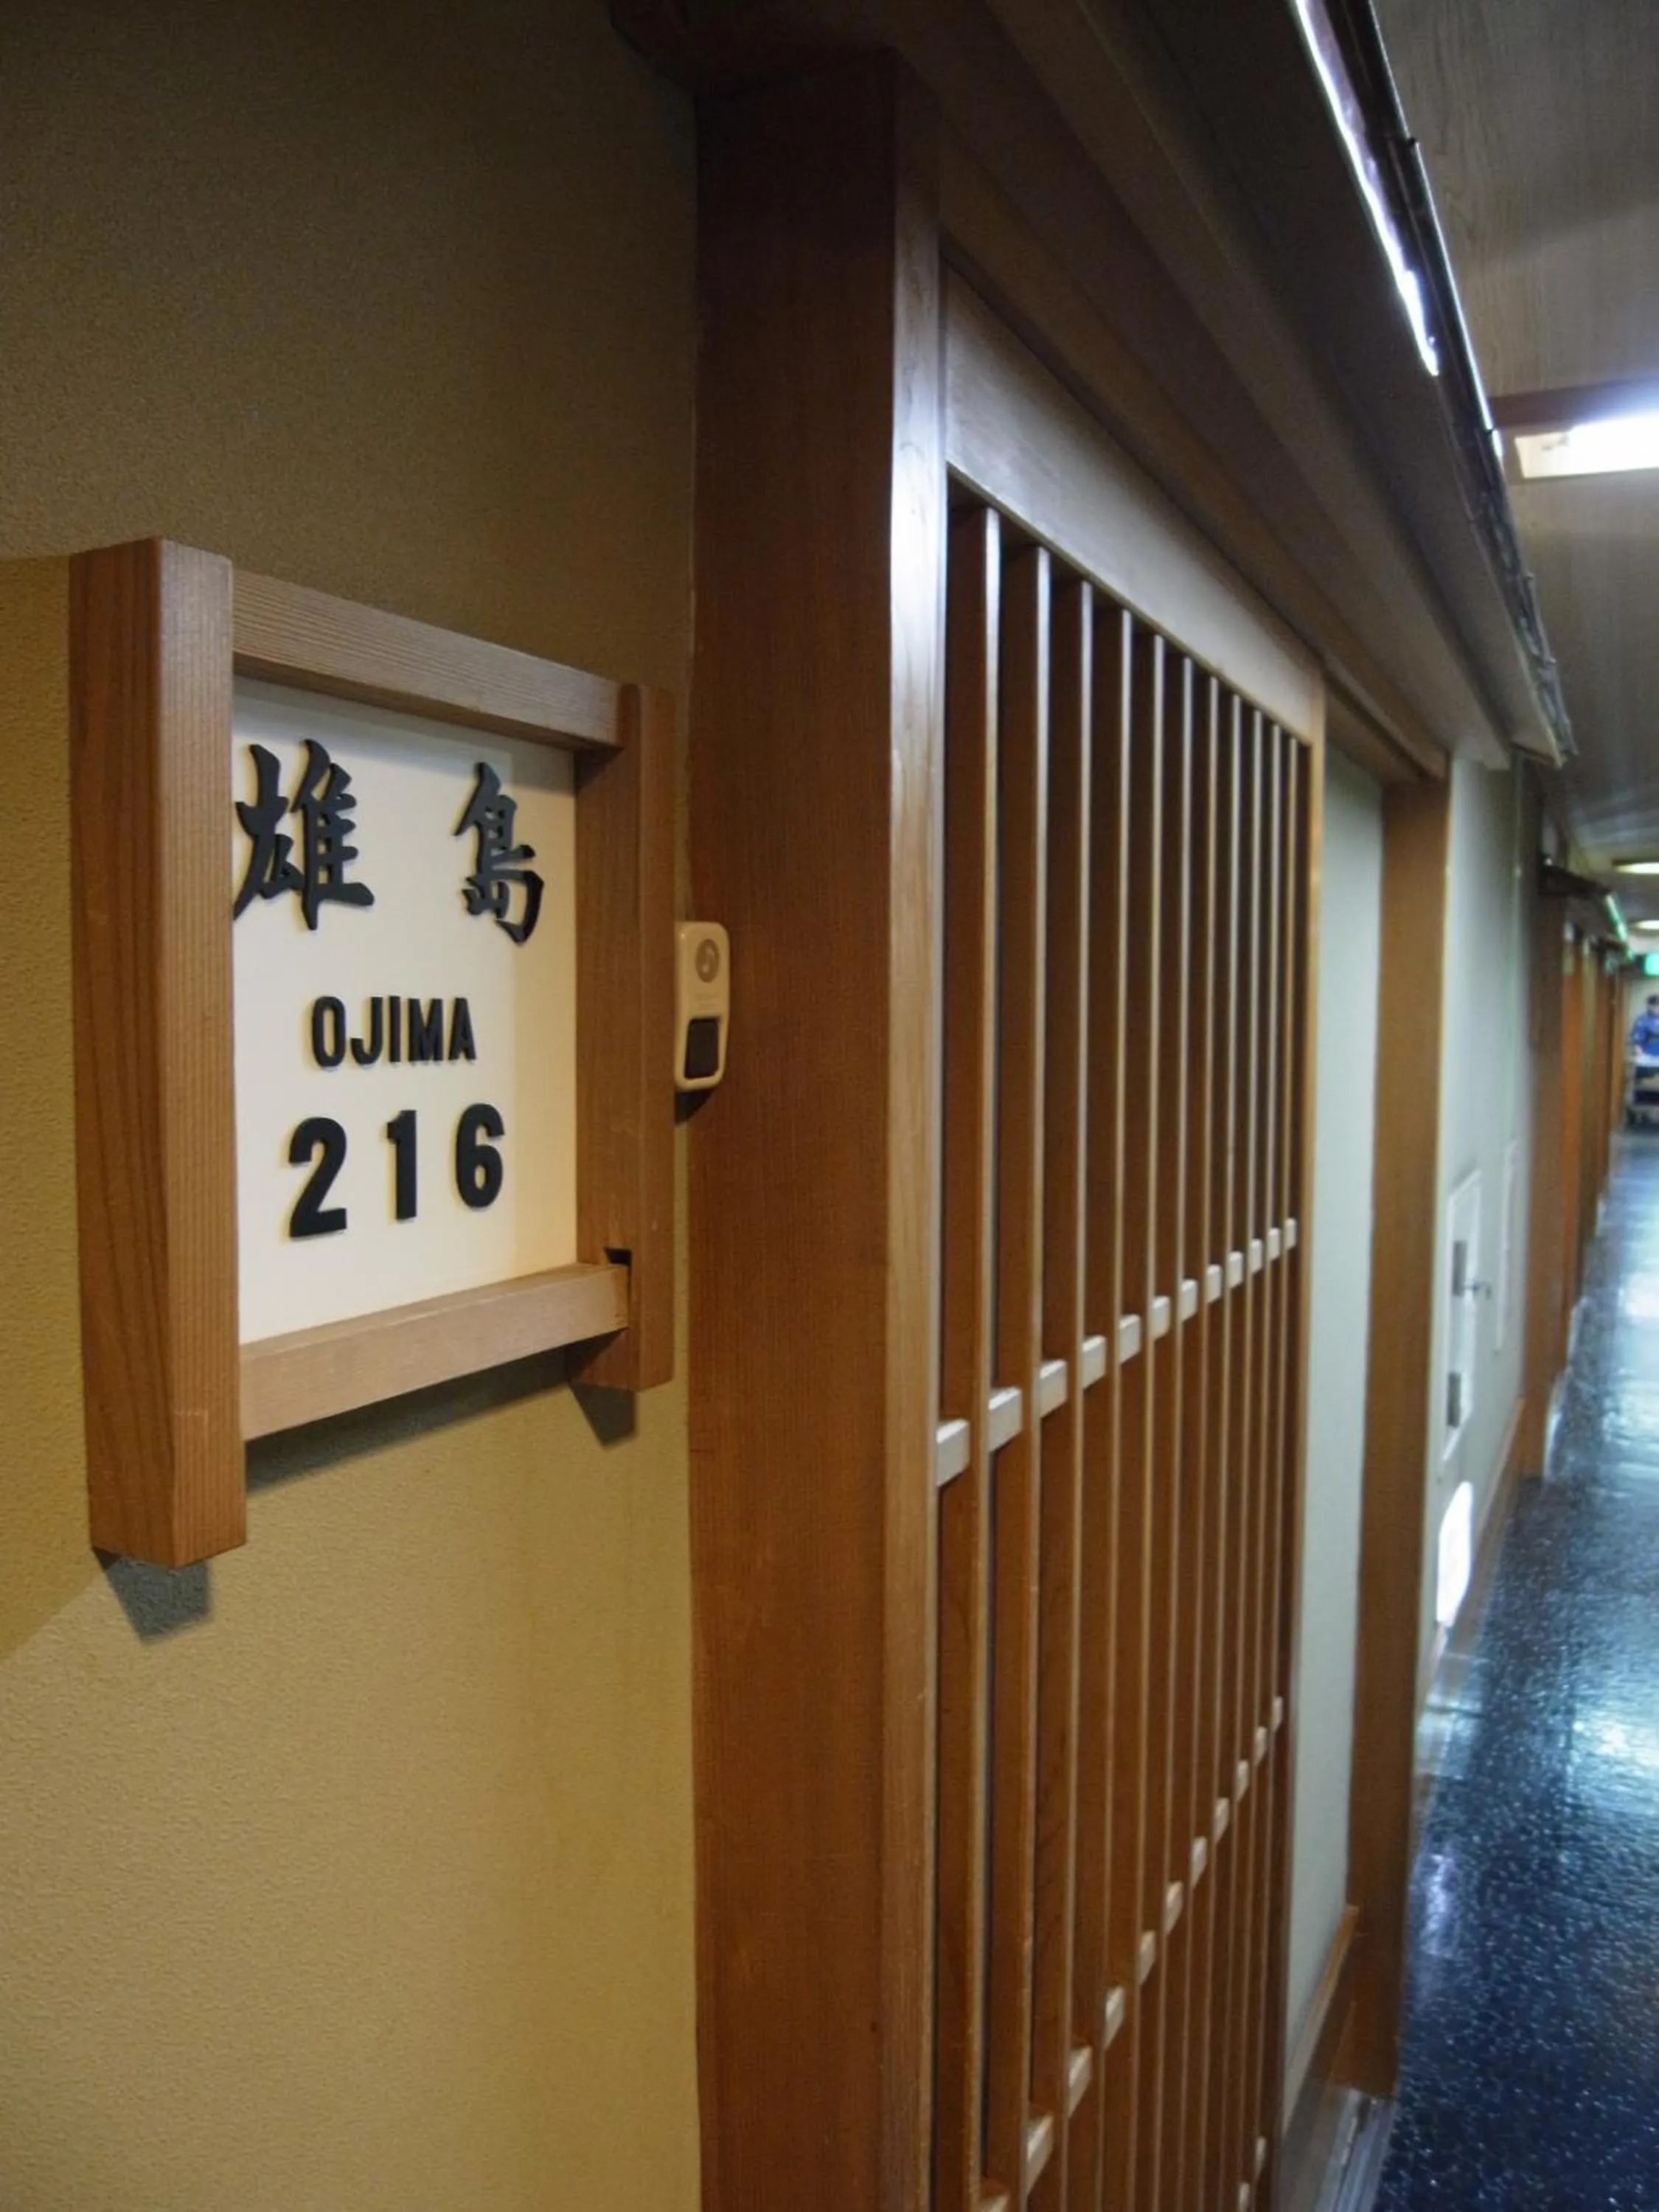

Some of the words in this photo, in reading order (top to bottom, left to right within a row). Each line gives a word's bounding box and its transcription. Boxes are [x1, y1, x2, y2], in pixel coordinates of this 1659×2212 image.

[232, 738, 546, 947] 雄島
[310, 995, 477, 1068] OJIMA
[288, 1103, 505, 1239] 216
